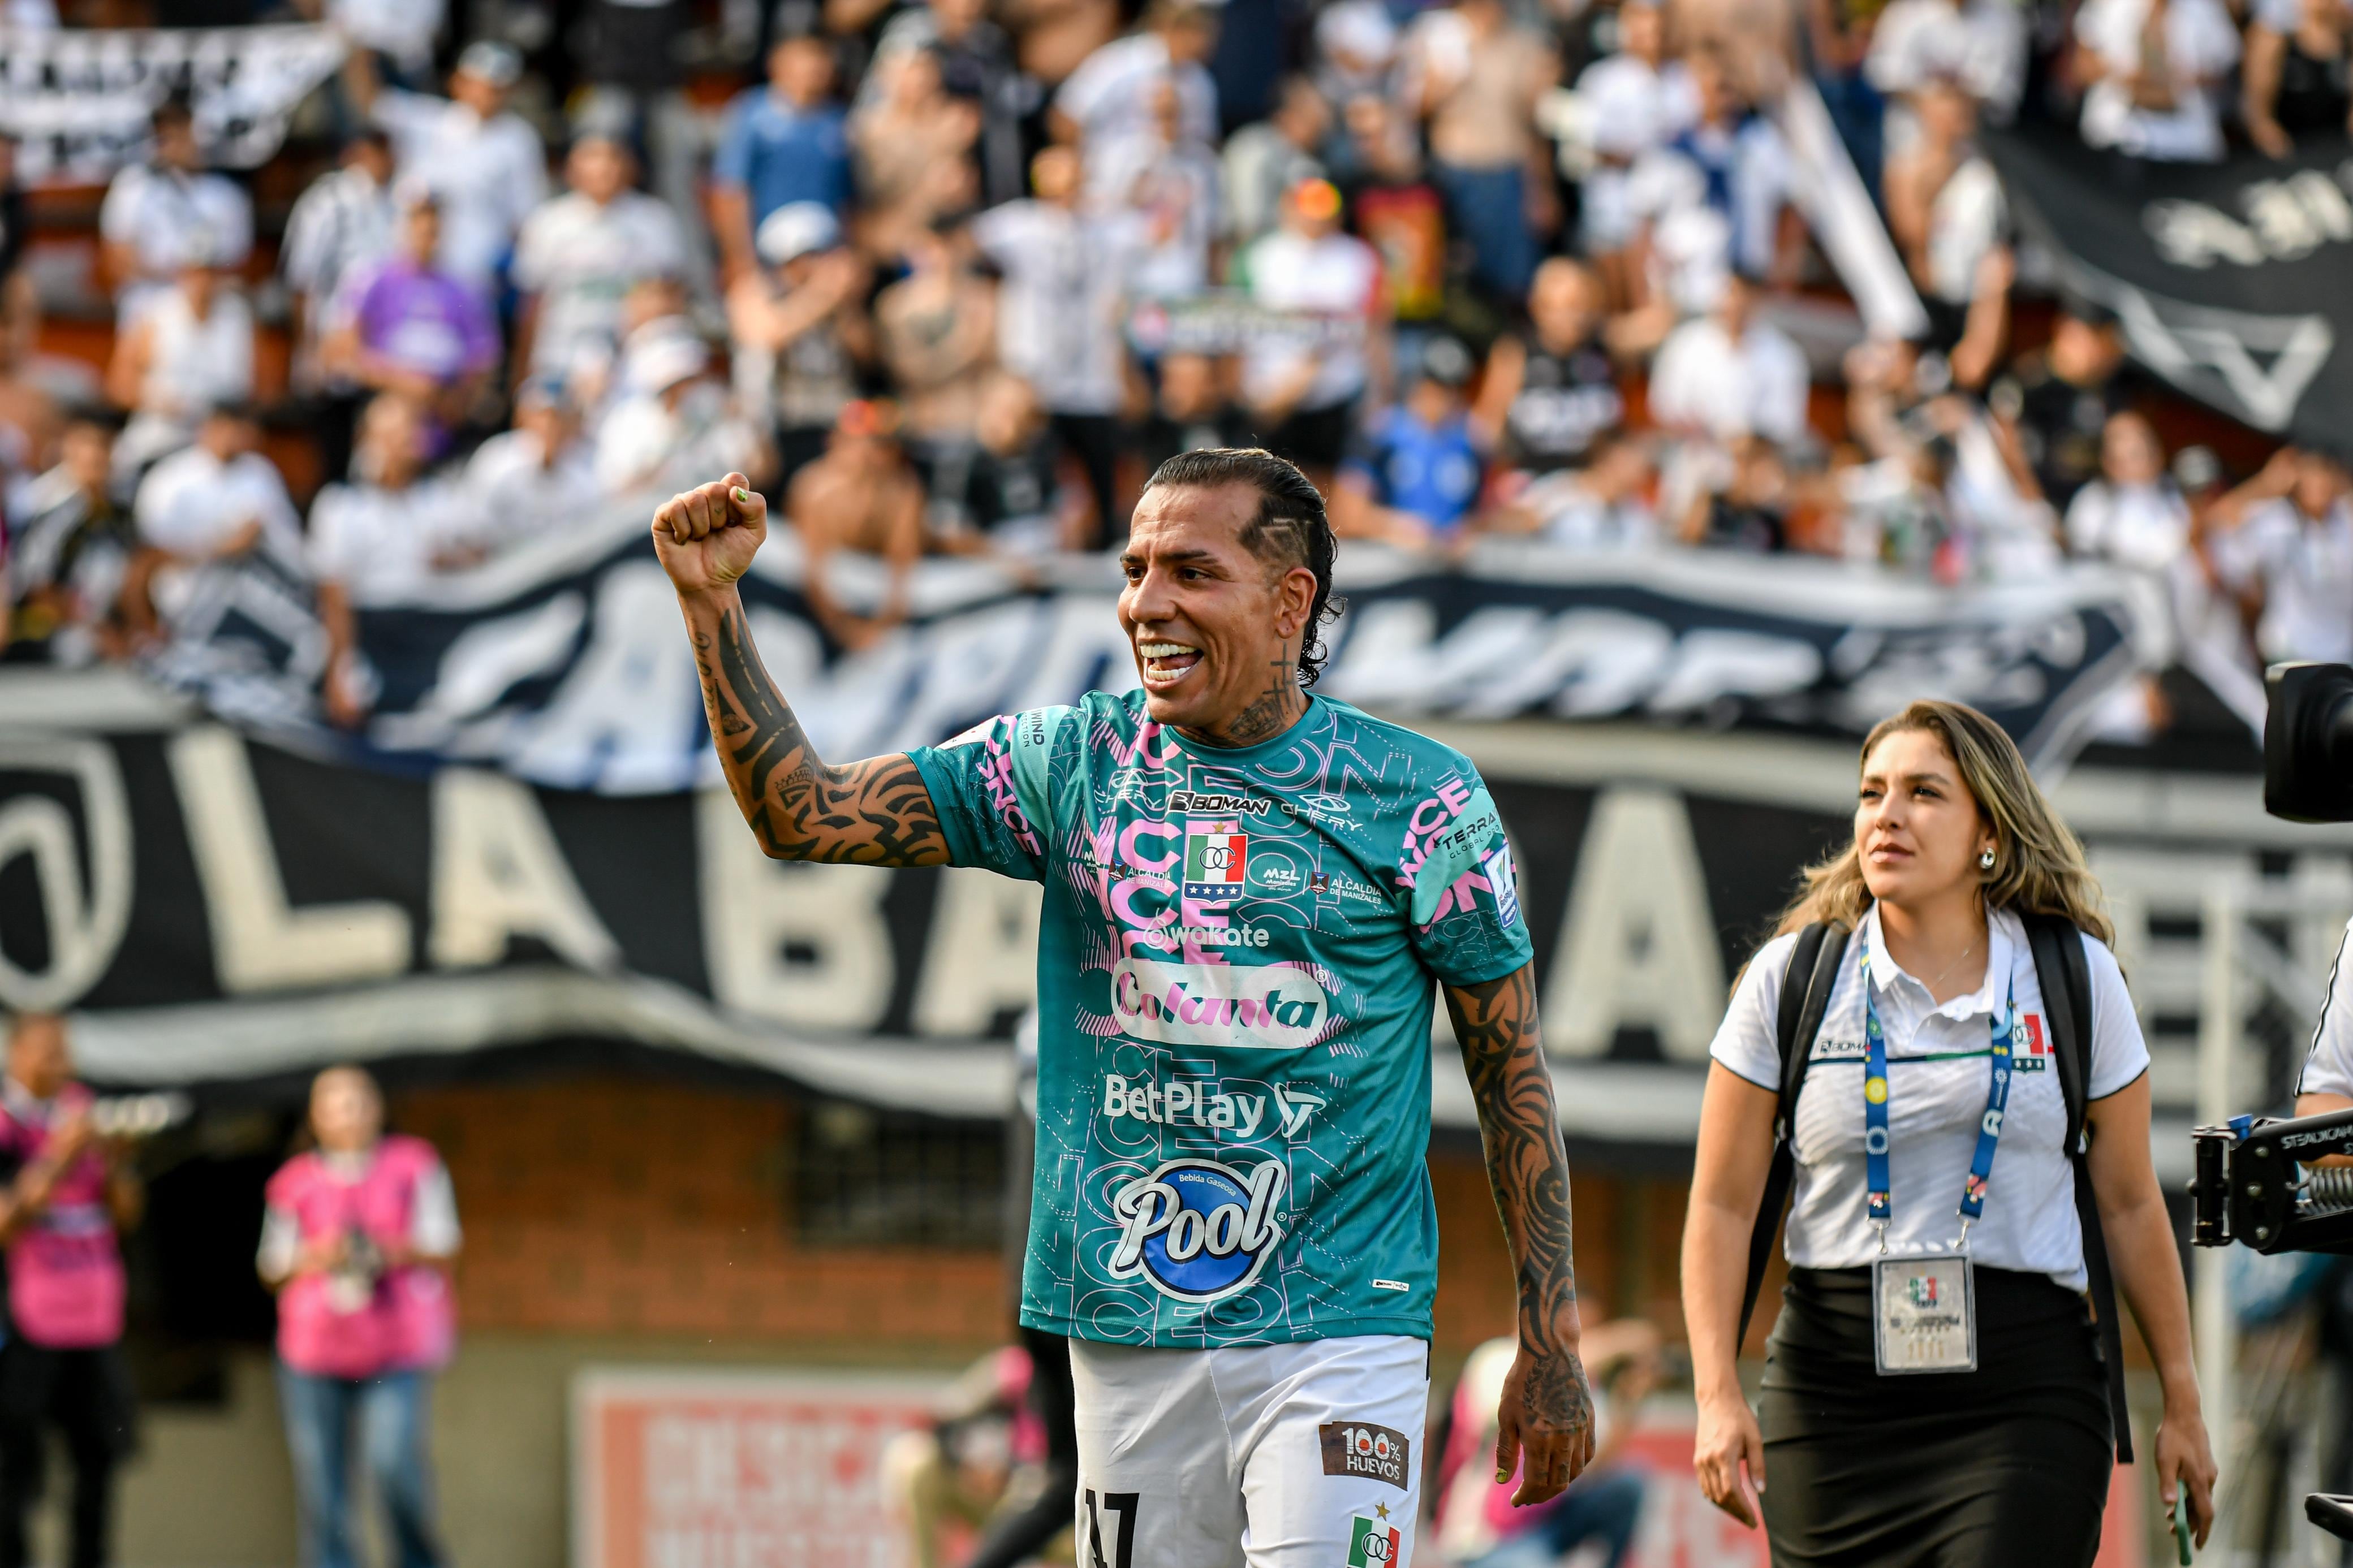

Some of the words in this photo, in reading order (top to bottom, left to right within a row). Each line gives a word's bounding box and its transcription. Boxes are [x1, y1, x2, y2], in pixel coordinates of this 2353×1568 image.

[1190, 794, 1272, 817] BOMAN
[1281, 803, 1364, 831] CHERY
[1450, 837, 1484, 859] GLOBAL
[1341, 891, 1382, 905] MANIZALES
[1115, 971, 1319, 1030] Colanta
[1104, 1074, 1266, 1138] BetPlay
[1179, 1174, 1205, 1182] Bebida
[1206, 1177, 1237, 1197] Gaseosa
[1115, 1165, 1278, 1272] Pool
[1342, 1427, 1401, 1462] 100%
[1347, 1455, 1400, 1480] HUEVOS
